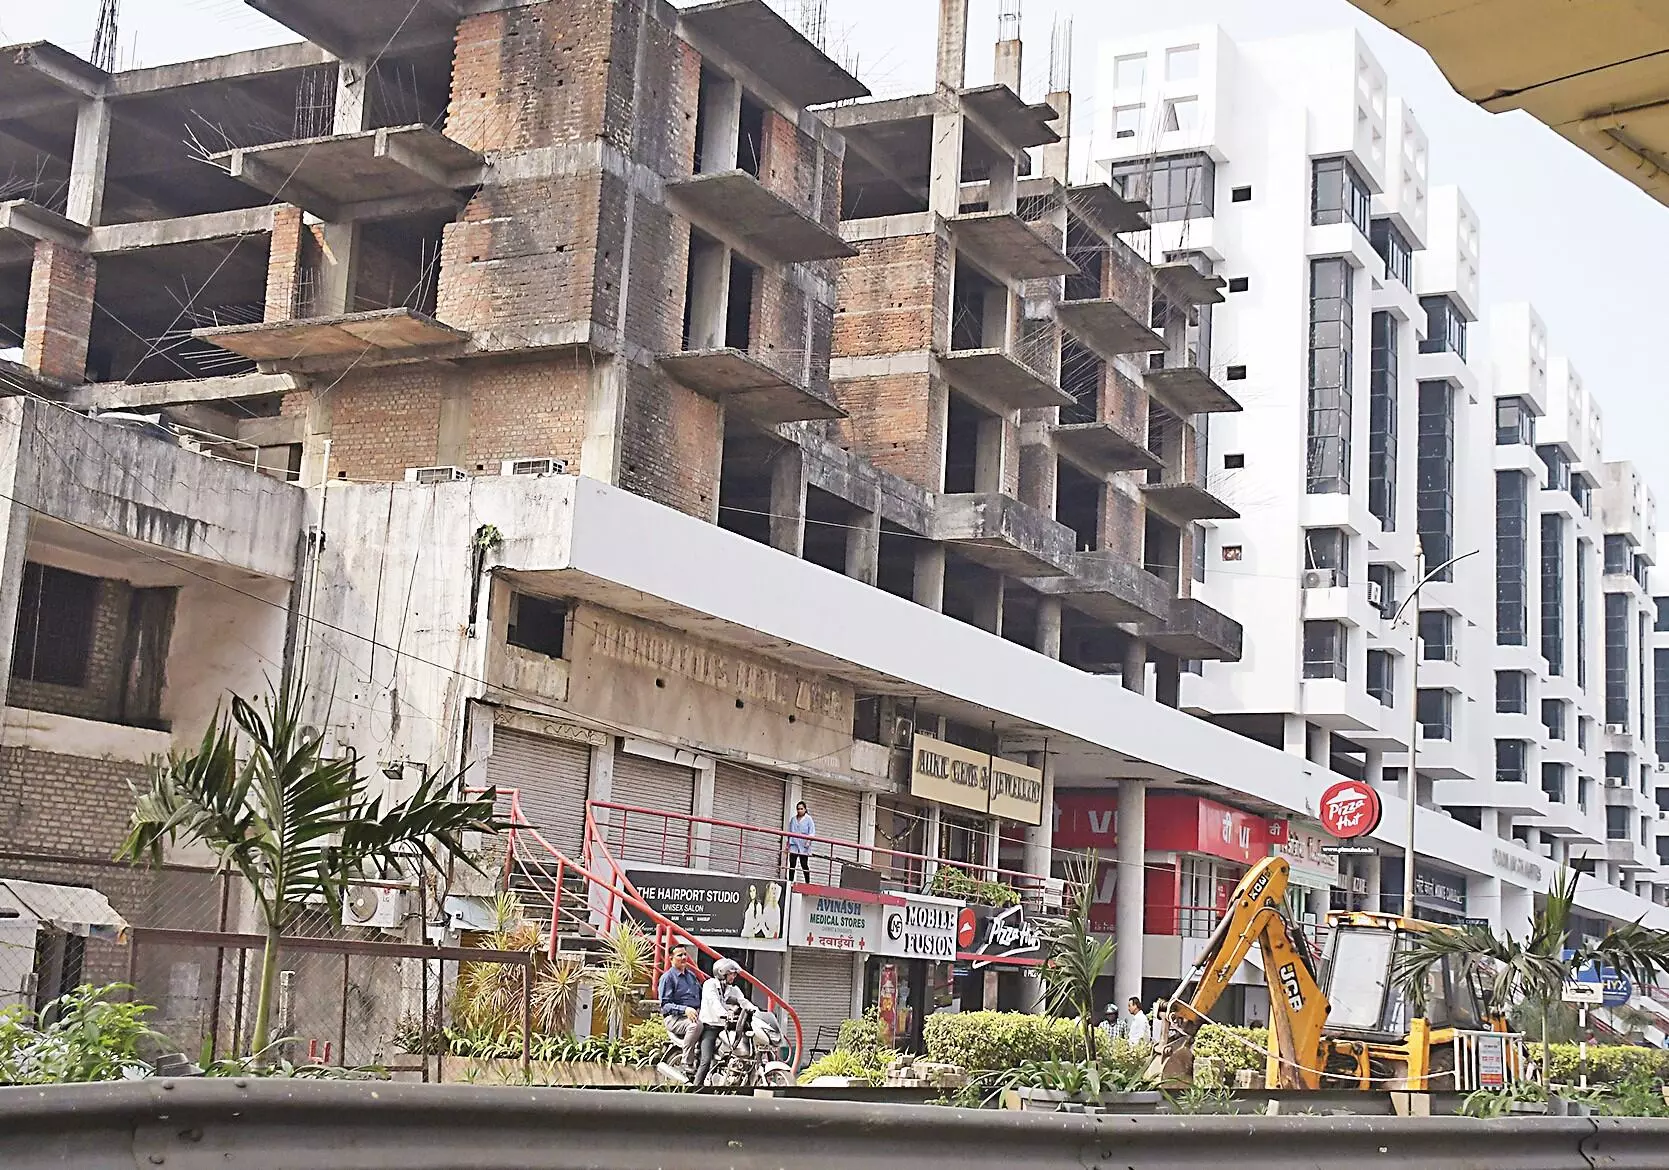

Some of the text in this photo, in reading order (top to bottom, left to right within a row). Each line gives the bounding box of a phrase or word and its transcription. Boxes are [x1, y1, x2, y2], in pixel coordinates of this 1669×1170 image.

[979, 766, 989, 790] &
[1329, 800, 1366, 830] Pizza Hut
[1222, 812, 1232, 844] वी
[636, 886, 740, 903] THE HAIRPORT STUDIO
[817, 898, 861, 915] AVINASH
[662, 903, 704, 912] UNISEX SALON
[906, 906, 954, 930] MOBILE
[810, 913, 866, 928] MEDICAL STORES
[990, 917, 1019, 946] Pizza
[904, 933, 953, 956] FUSION
[1280, 964, 1303, 1011] JCB
